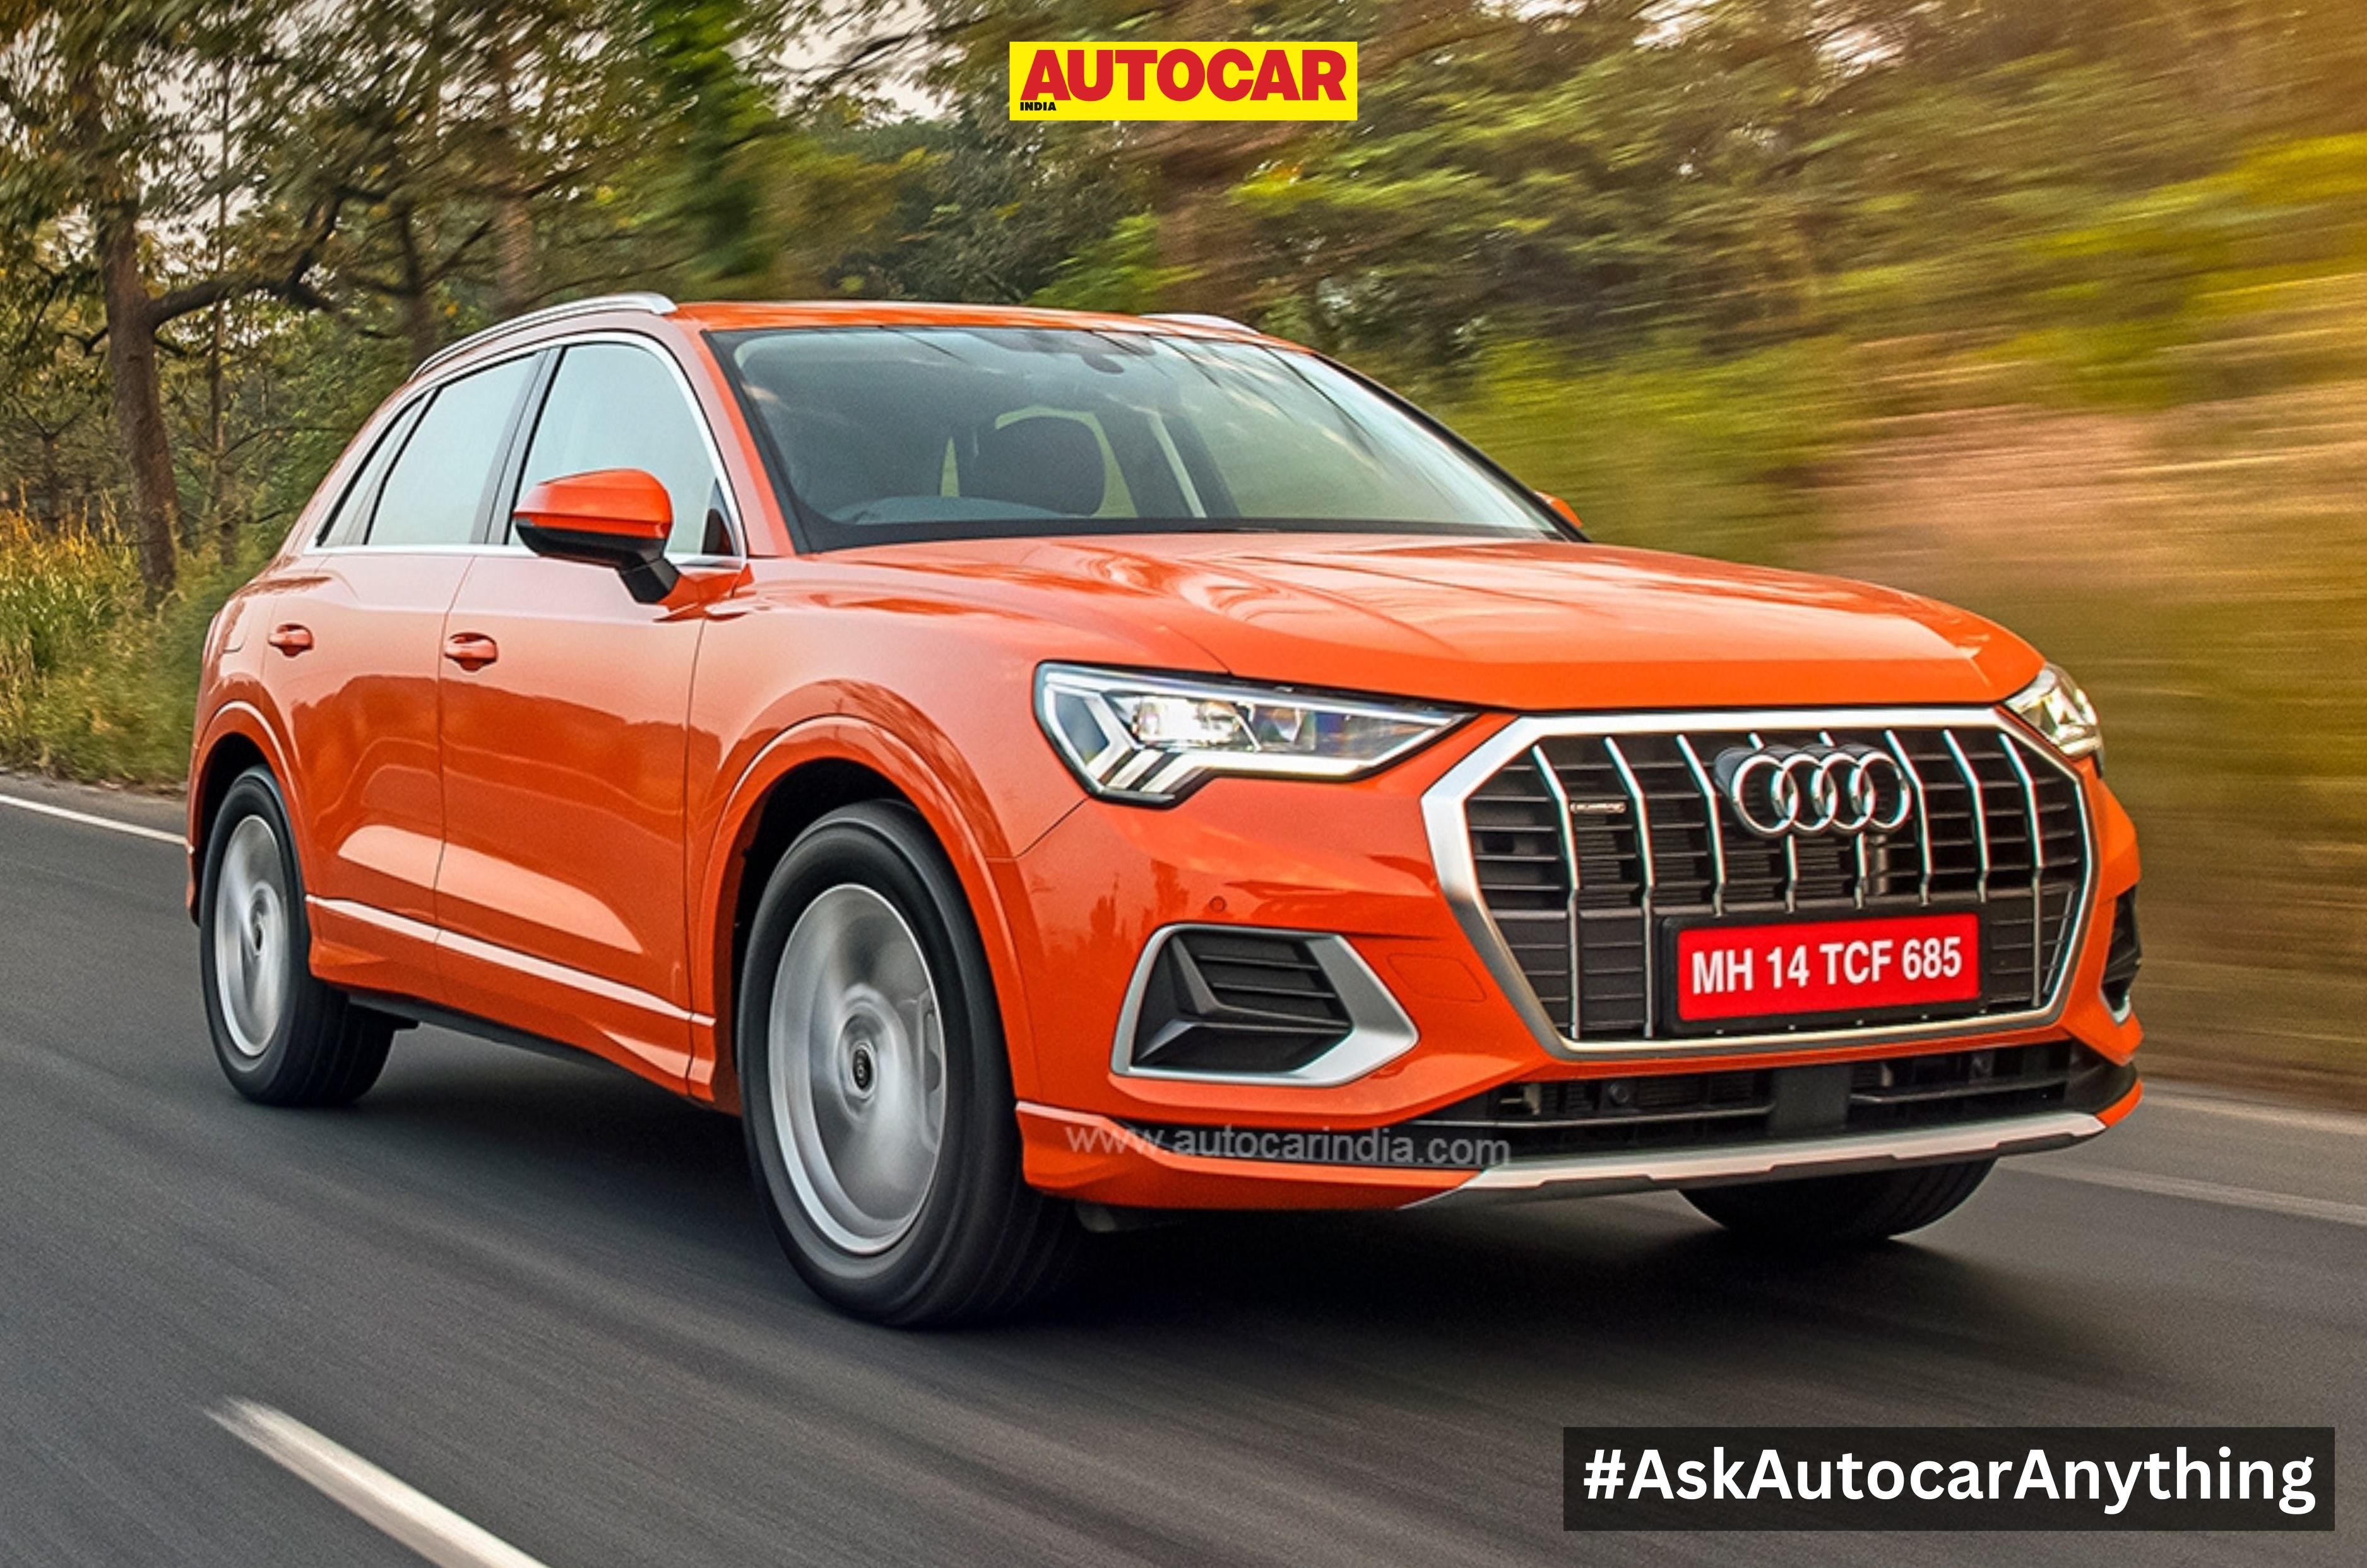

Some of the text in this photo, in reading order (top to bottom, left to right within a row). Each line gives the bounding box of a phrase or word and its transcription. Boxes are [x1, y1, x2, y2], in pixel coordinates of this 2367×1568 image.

[1692, 936, 1962, 994] MH 14 TCF 685
